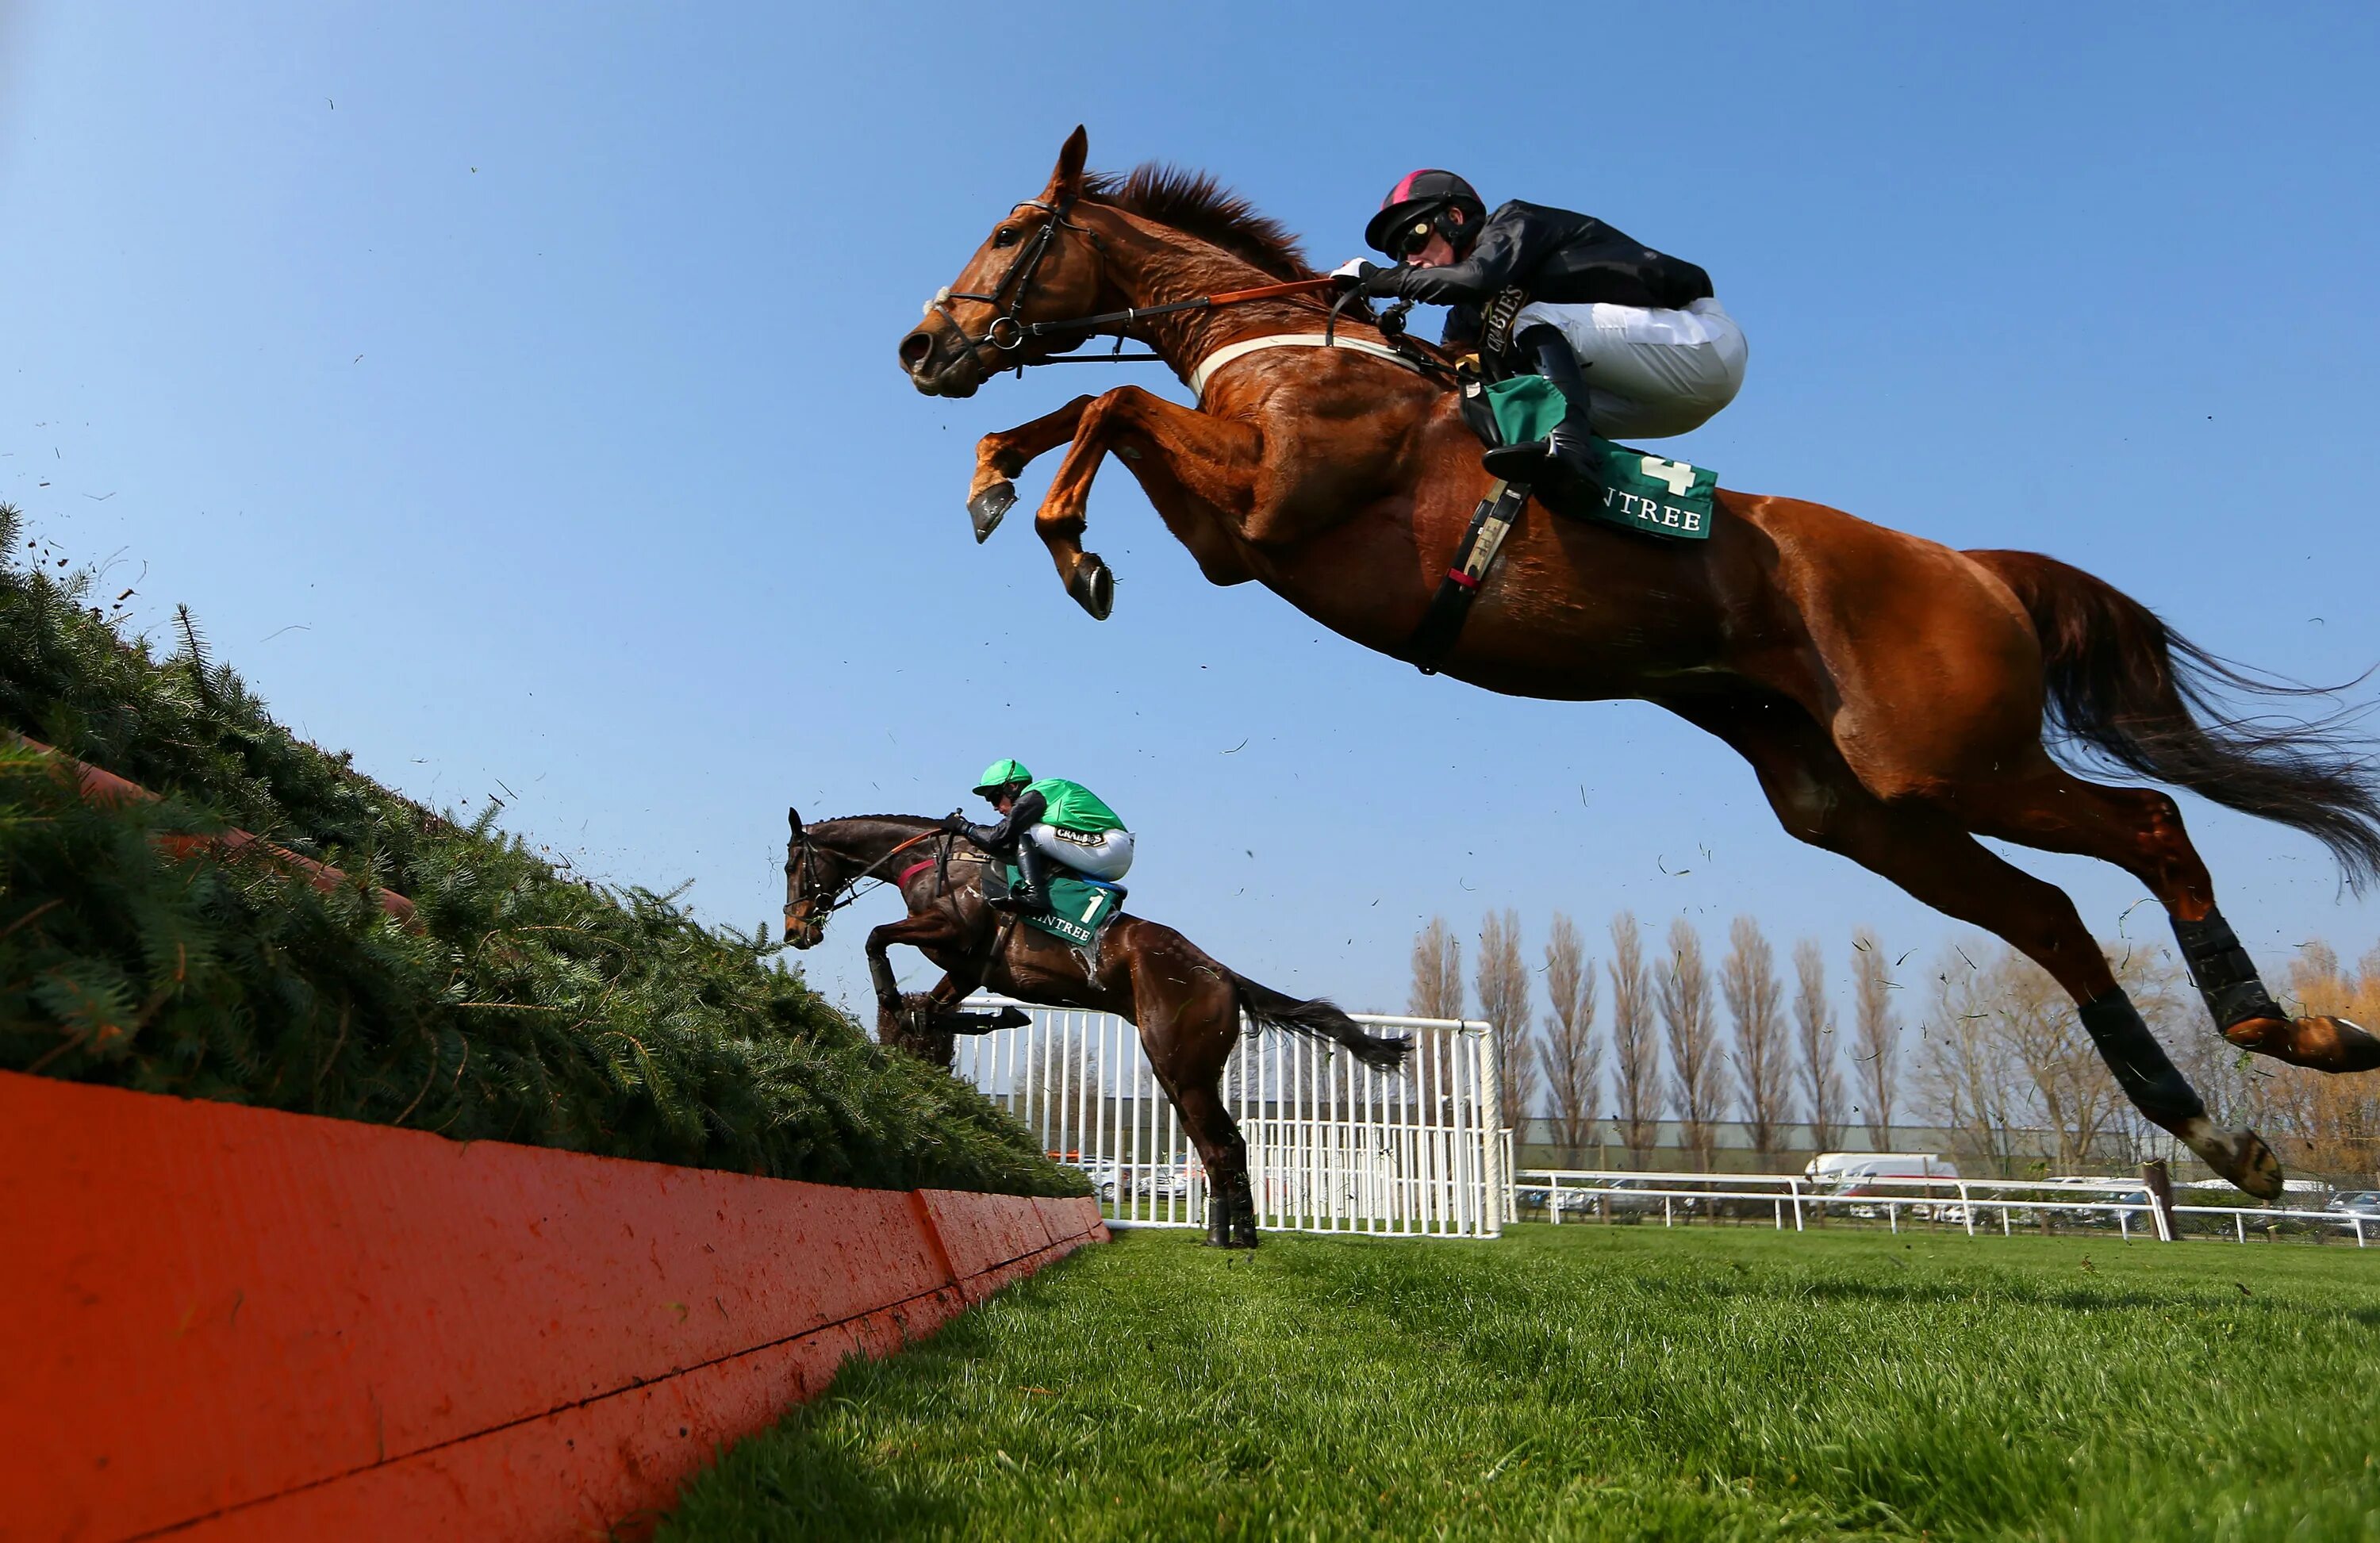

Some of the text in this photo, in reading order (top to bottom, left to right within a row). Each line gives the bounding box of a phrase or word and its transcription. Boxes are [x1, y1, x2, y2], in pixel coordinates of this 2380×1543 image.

[1641, 455, 1696, 497] 4
[1603, 486, 1702, 532] NTREE
[1081, 894, 1105, 924] 1
